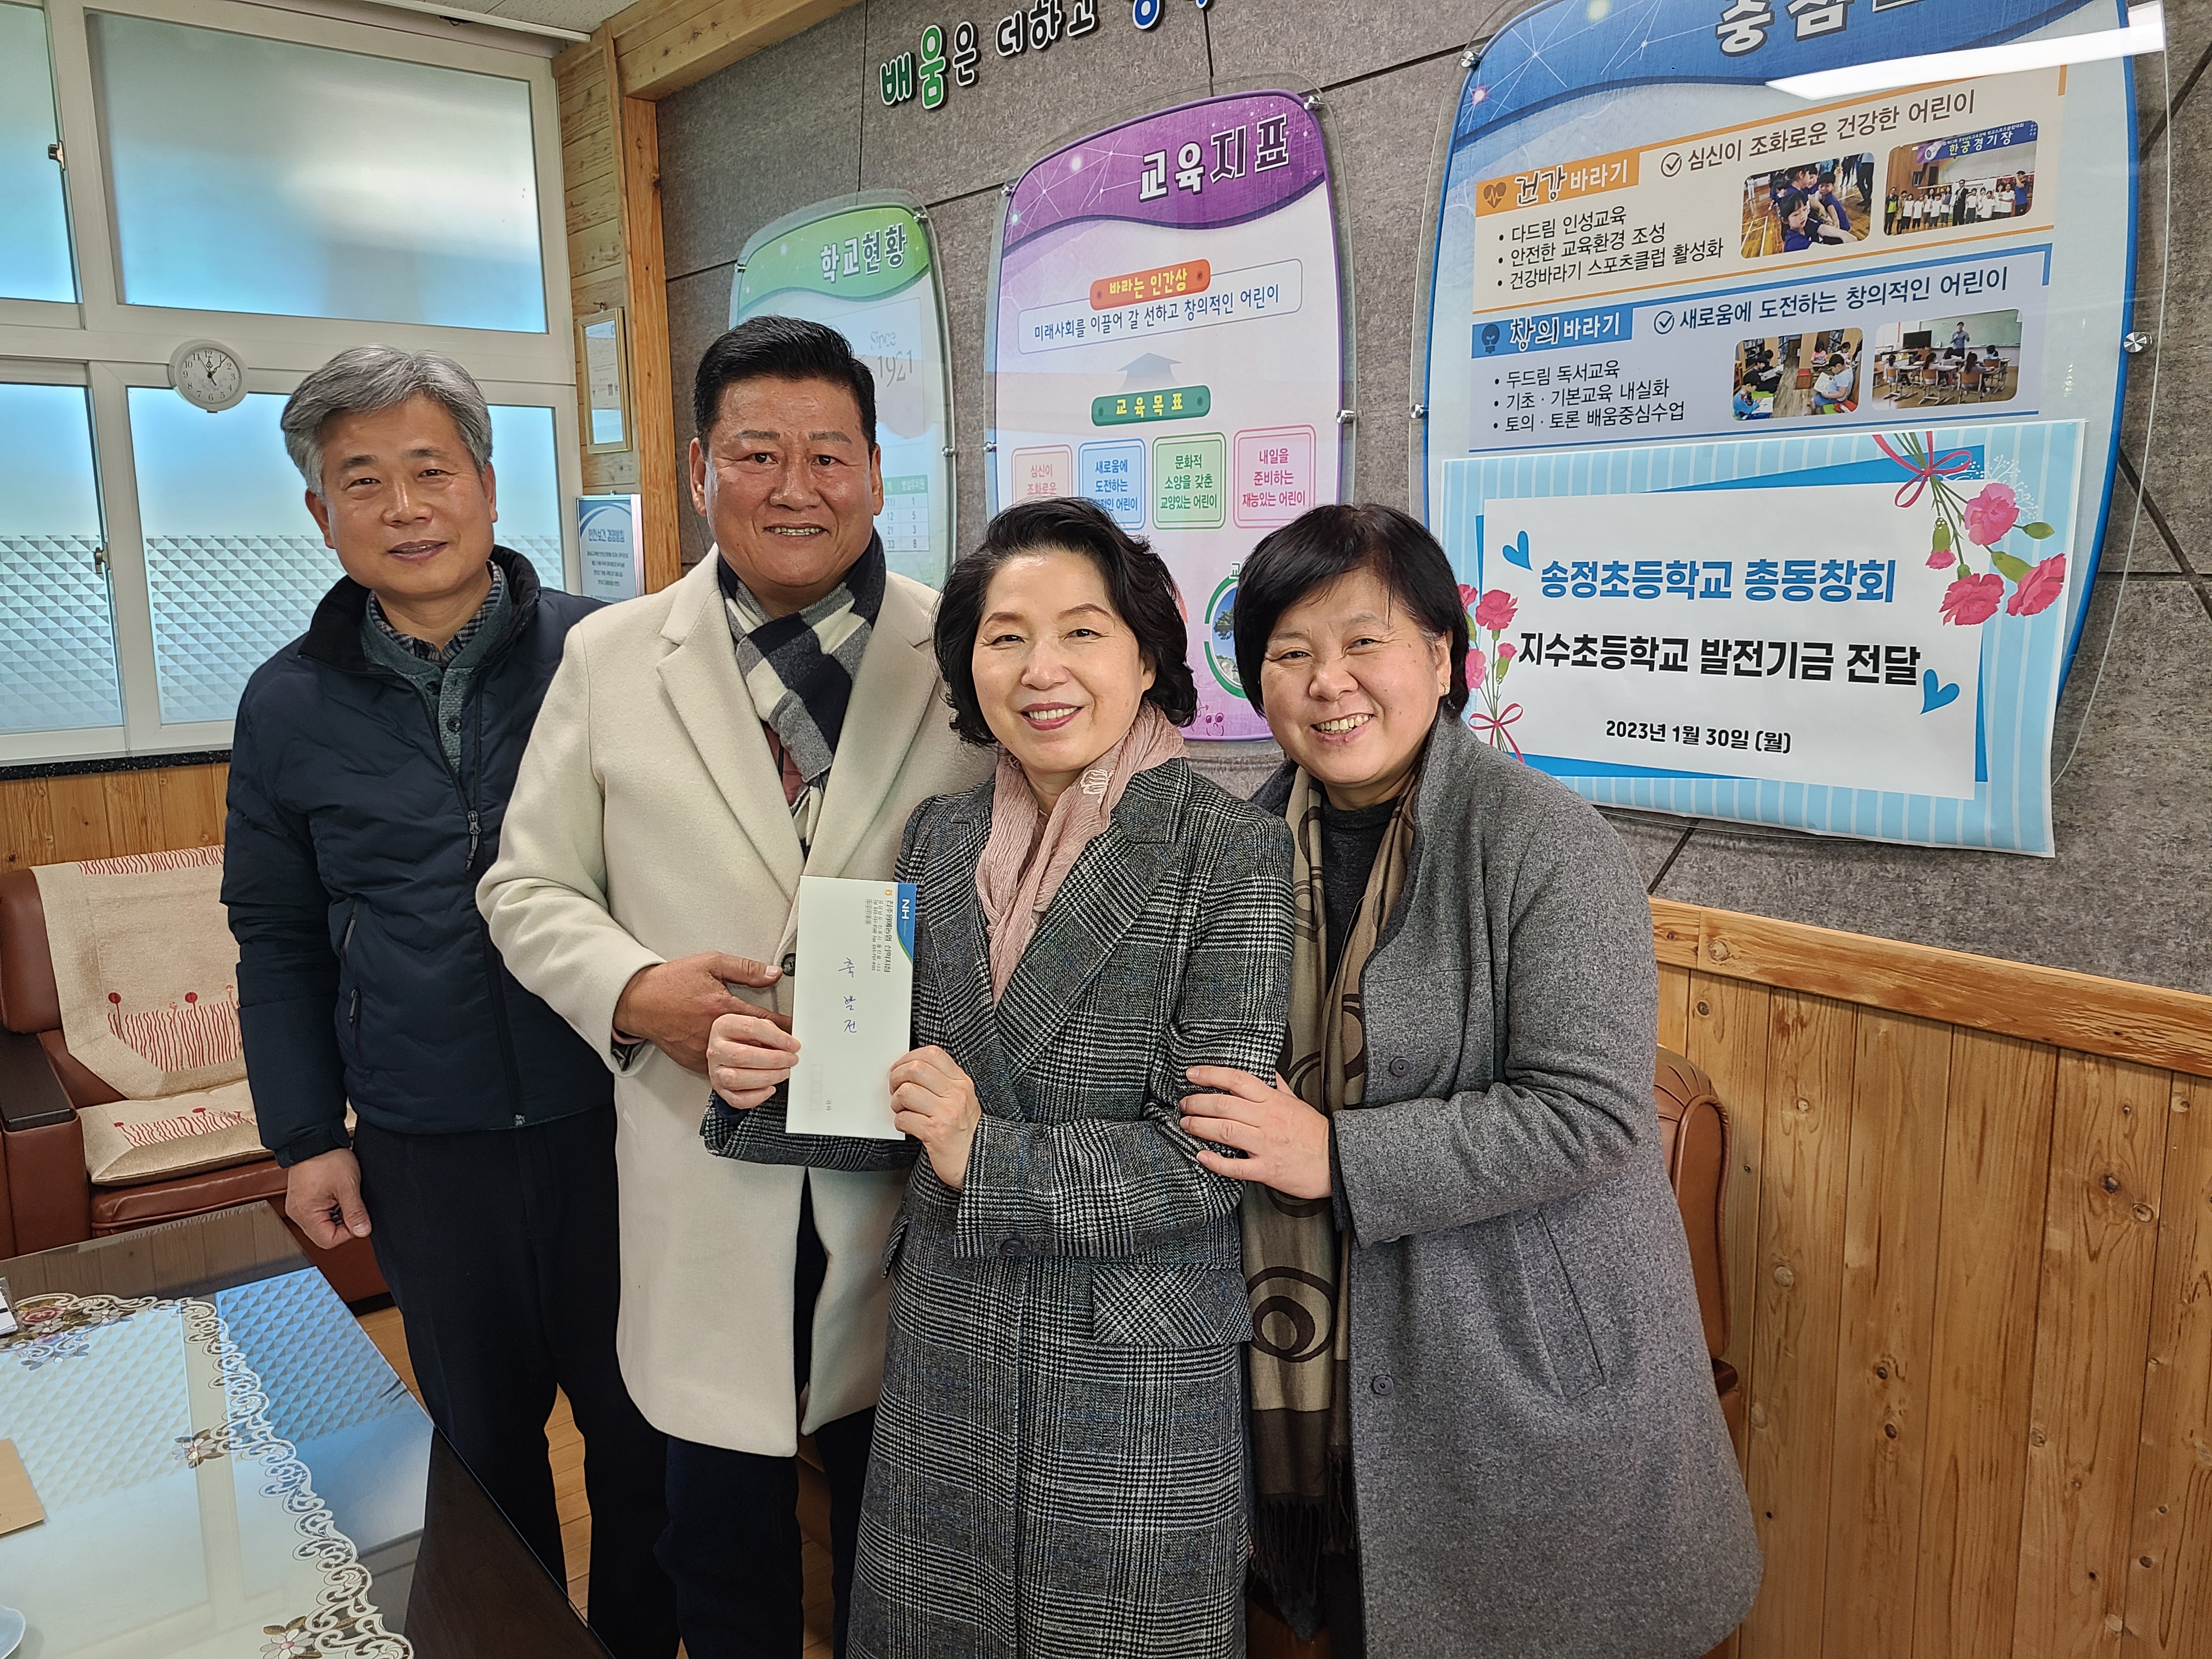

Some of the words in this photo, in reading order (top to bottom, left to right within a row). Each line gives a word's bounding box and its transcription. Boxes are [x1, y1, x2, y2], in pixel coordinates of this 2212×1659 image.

[879, 21, 978, 109] 배움은
[995, 0, 1098, 57] 더하고
[1688, 139, 1742, 171] 심신이
[1748, 121, 1827, 157] 조화로운
[1836, 105, 1899, 139] 건강한
[1908, 89, 1975, 124] 어린이
[1949, 131, 2013, 156] 한궁경기장
[1139, 113, 1290, 202] 교육지표
[1514, 165, 1566, 207] 건강
[1570, 159, 1628, 191] 바라기
[1511, 218, 1556, 244] 다드림
[1562, 206, 1626, 235] 인성교육
[821, 223, 907, 282] 학교현황
[1510, 242, 1556, 267] 안전한
[1561, 229, 1625, 258] 교육환경
[1631, 222, 1666, 246] 조성
[1510, 261, 1582, 290] 건강바라기
[1587, 246, 1666, 277] 스포츠클럽
[1672, 238, 1724, 264] 활성화
[1109, 278, 1144, 300] 바라는
[1150, 268, 1188, 297] 인간상
[1679, 301, 1752, 330] 새로움에
[1759, 289, 1837, 317] 도전하는
[1846, 275, 1931, 311] 창의적인
[1940, 266, 2008, 298] 어린이
[1034, 317, 1086, 342] 미래사회를
[1090, 312, 1124, 335] 이끌어
[1128, 311, 1140, 331] 갈
[1143, 303, 1180, 328] 선하고
[1183, 294, 1234, 321] 창의적인
[1240, 284, 1279, 310] 어린이
[870, 331, 896, 349] Since
[1510, 316, 1560, 352] 창의
[1564, 312, 1620, 341] 바라기
[877, 349, 912, 387] 1921
[1506, 367, 1551, 390] 두드림
[1556, 359, 1621, 383] 독서교육
[1116, 393, 1184, 417] 교육목표
[1505, 392, 1536, 411] 기초
[1550, 384, 1613, 407] 기본교육
[1620, 377, 1669, 402] 내실화
[1505, 413, 1534, 432] 토의
[1549, 410, 1581, 430] 토론
[1587, 400, 1685, 427] 배움중심수업
[1094, 459, 1128, 474] 새로움에
[1175, 454, 1202, 470] 문화적
[1259, 448, 1289, 465] 내일을
[1030, 464, 1053, 478] 심신이
[1164, 475, 1192, 490] 소양을
[1194, 473, 1214, 489] 갖춘
[1253, 470, 1294, 486] 준비하는
[1027, 482, 1057, 495] 조화로운
[1094, 478, 1128, 493] 도전하는
[912, 496, 915, 505] 1
[1116, 497, 1138, 511] 어린이
[1160, 495, 1191, 510] 교양있는
[1193, 494, 1217, 509] 어린이
[1242, 492, 1277, 508] 재능있는
[1279, 490, 1306, 507] 어린이
[887, 512, 894, 521] 12
[912, 511, 916, 520] 5
[887, 526, 894, 535] 21
[912, 525, 917, 534] 3
[1230, 563, 1240, 577] 교
[1541, 560, 1733, 601] 송정초등학교
[1743, 557, 1897, 604] 총동창회
[1517, 631, 1690, 674] 지수초등학교
[1700, 639, 1834, 682] 발전기금
[1846, 642, 1921, 686] 전달
[1606, 720, 1667, 743] 2023년
[1672, 725, 1701, 747] 1월
[1706, 727, 1750, 751] 30일
[1754, 730, 1792, 754] (월)
[901, 899, 910, 919] NH
[838, 957, 855, 978] 축
